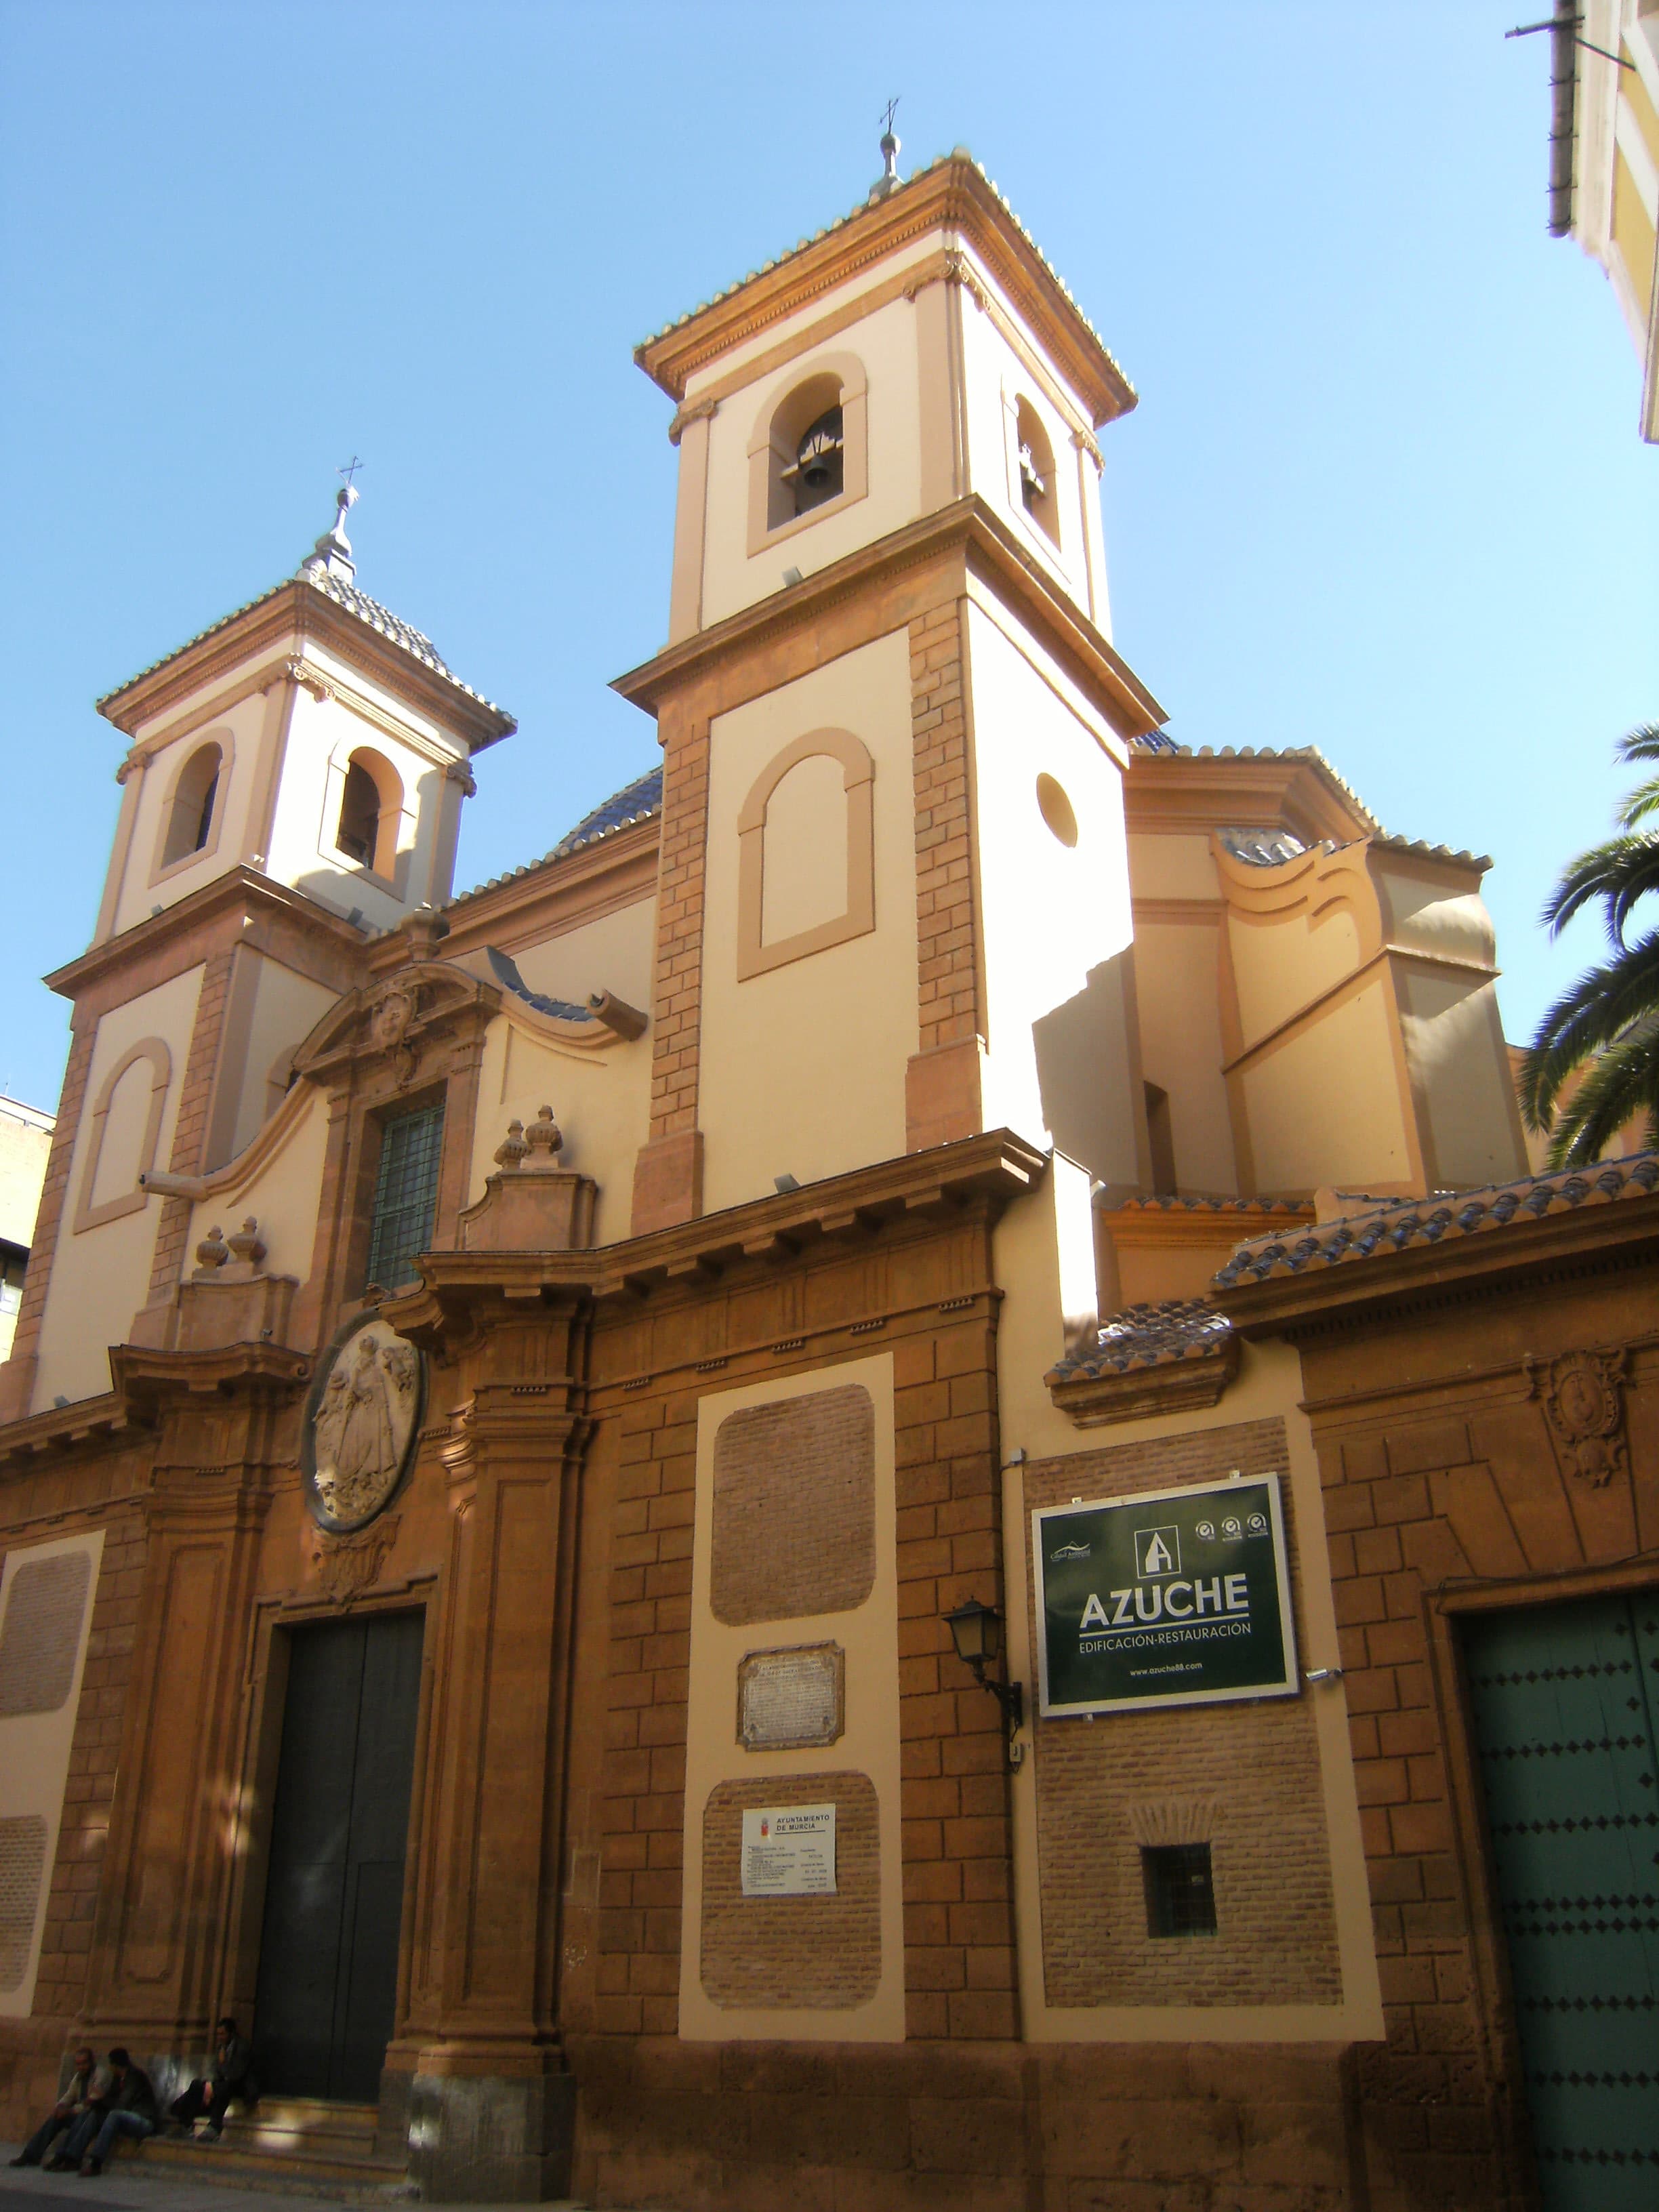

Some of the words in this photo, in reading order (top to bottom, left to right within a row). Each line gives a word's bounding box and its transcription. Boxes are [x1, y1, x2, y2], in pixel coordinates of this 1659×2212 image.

[1080, 1573, 1249, 1629] AZUCHE
[1079, 1622, 1252, 1654] EDIFICACIÓN-RESTAURACIÓN
[777, 1814, 830, 1824] AYUNTAMIENTO
